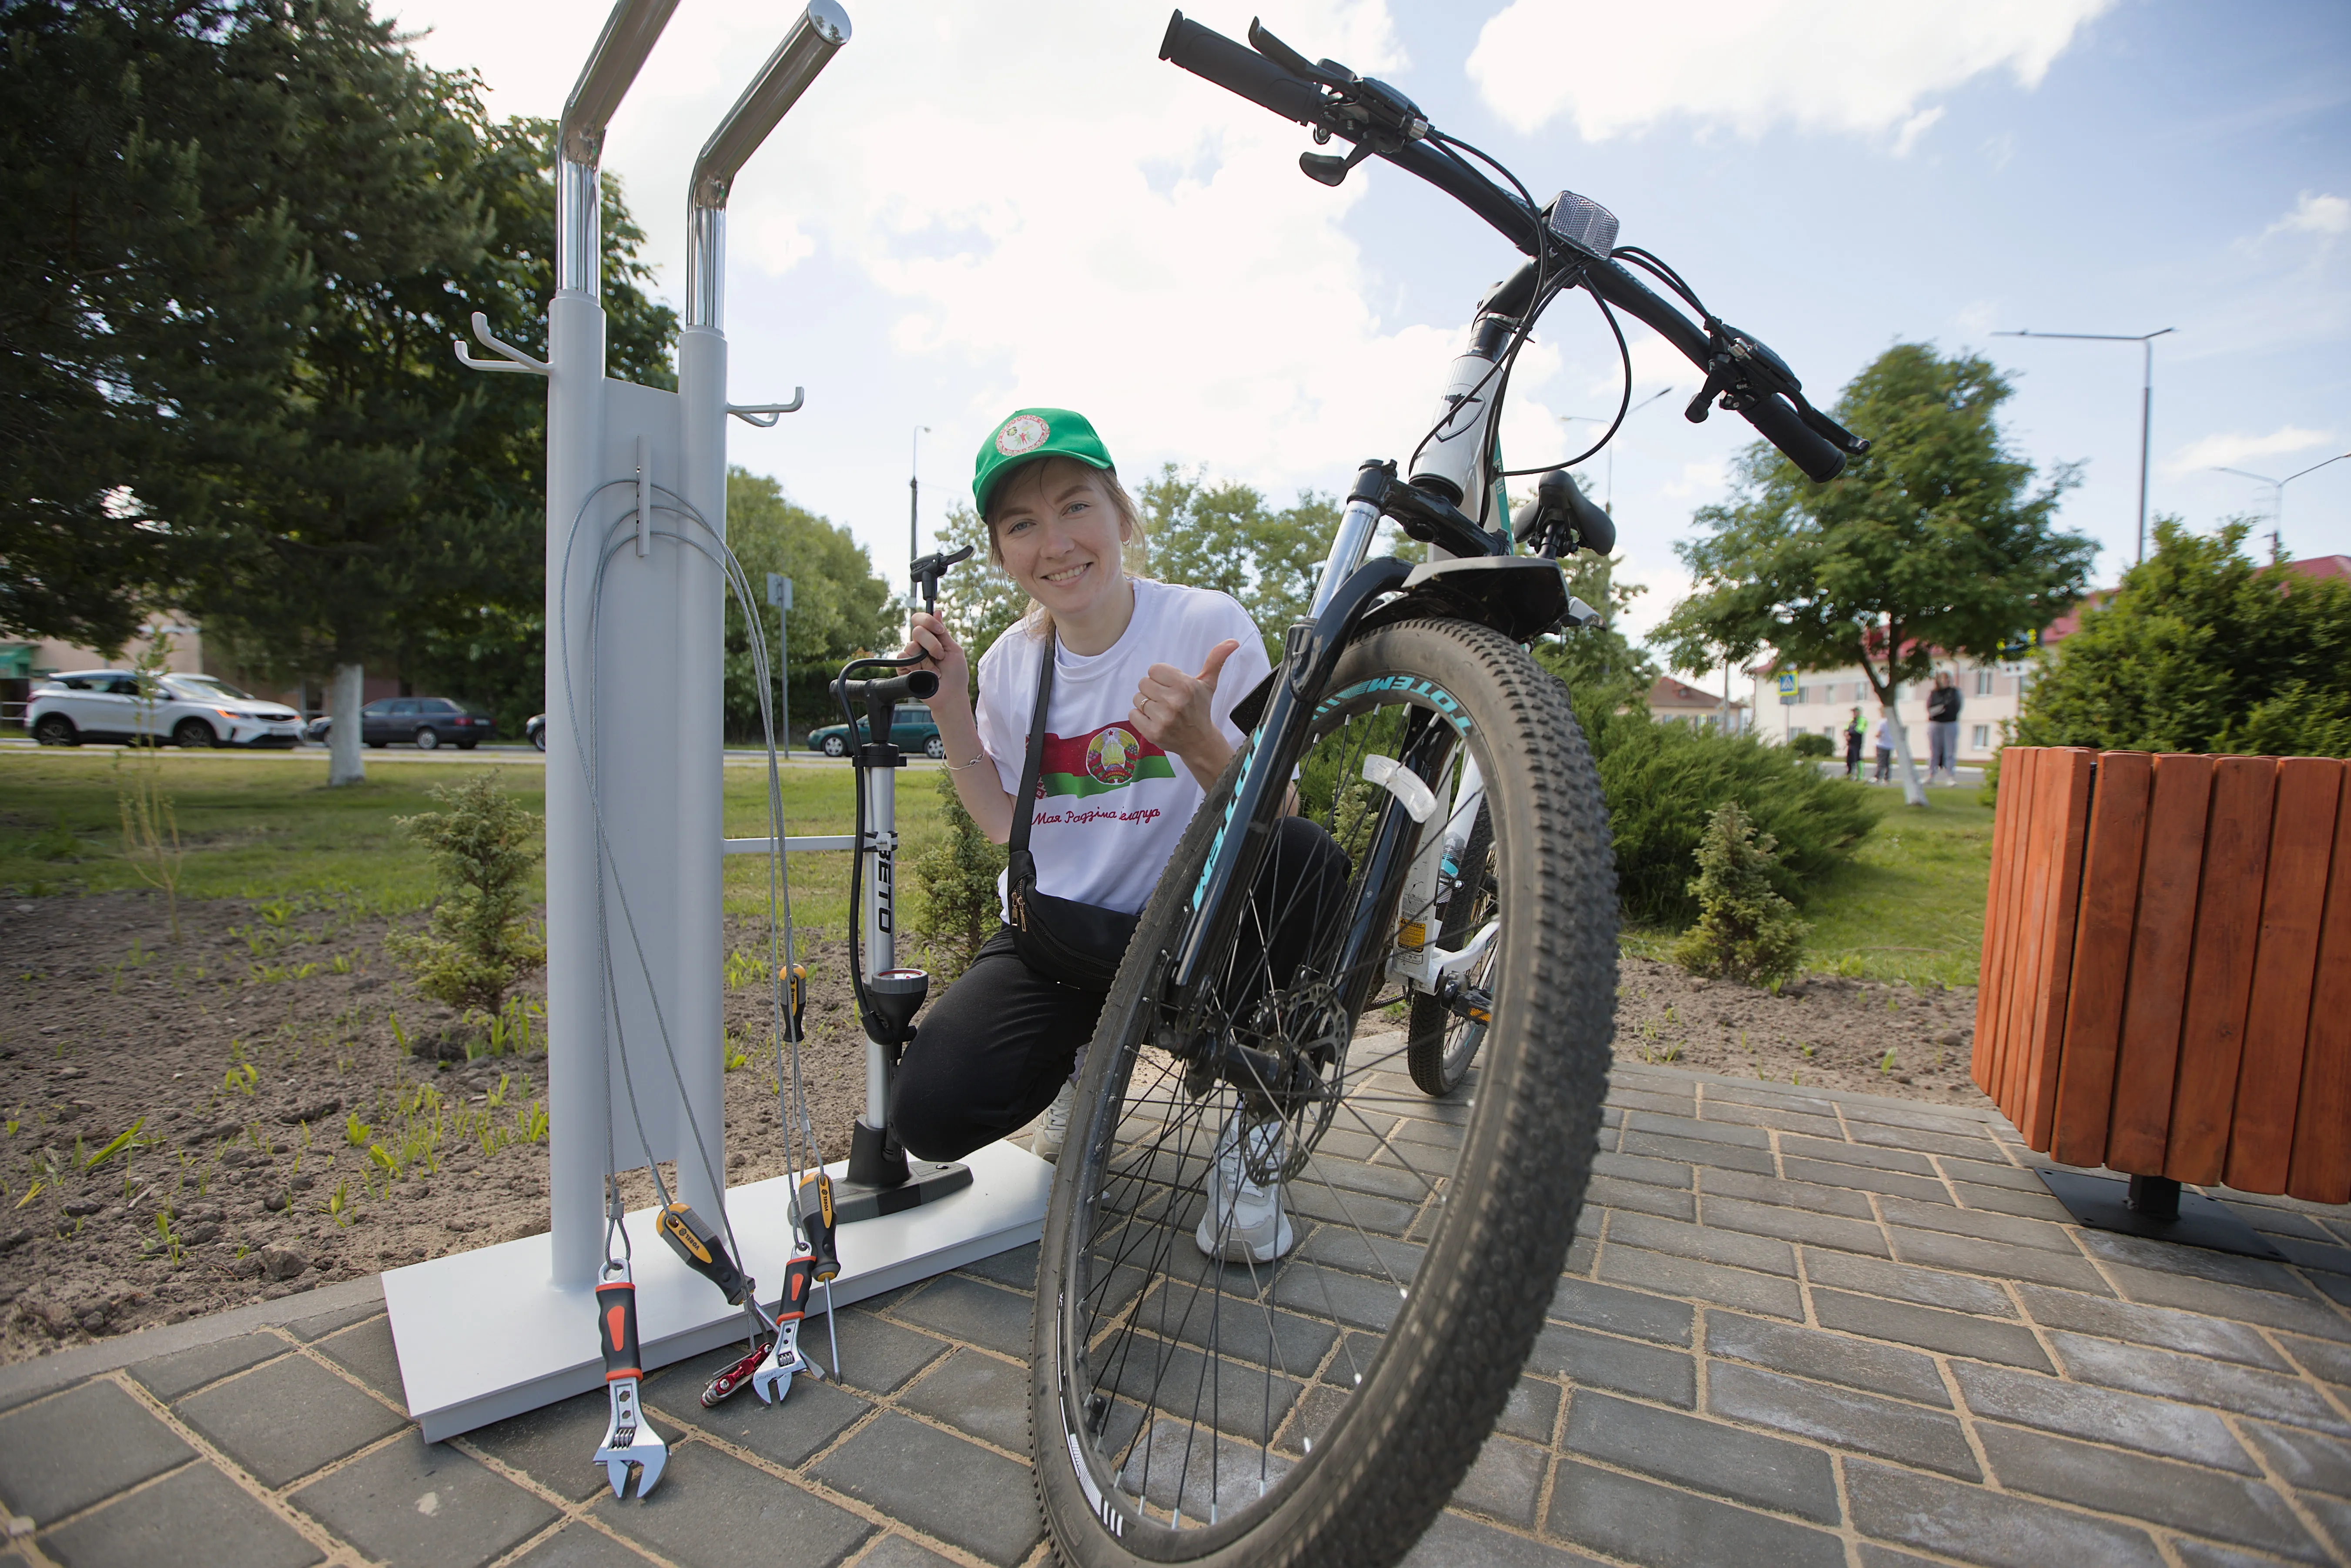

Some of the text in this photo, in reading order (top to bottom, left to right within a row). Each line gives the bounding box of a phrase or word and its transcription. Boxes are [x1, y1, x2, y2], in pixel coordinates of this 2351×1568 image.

[1366, 676, 1472, 737] TOTEM
[1031, 806, 1161, 826] Мая Радзіма еларусь
[1192, 723, 1266, 912] TOTEM
[685, 1234, 700, 1251] VOREL
